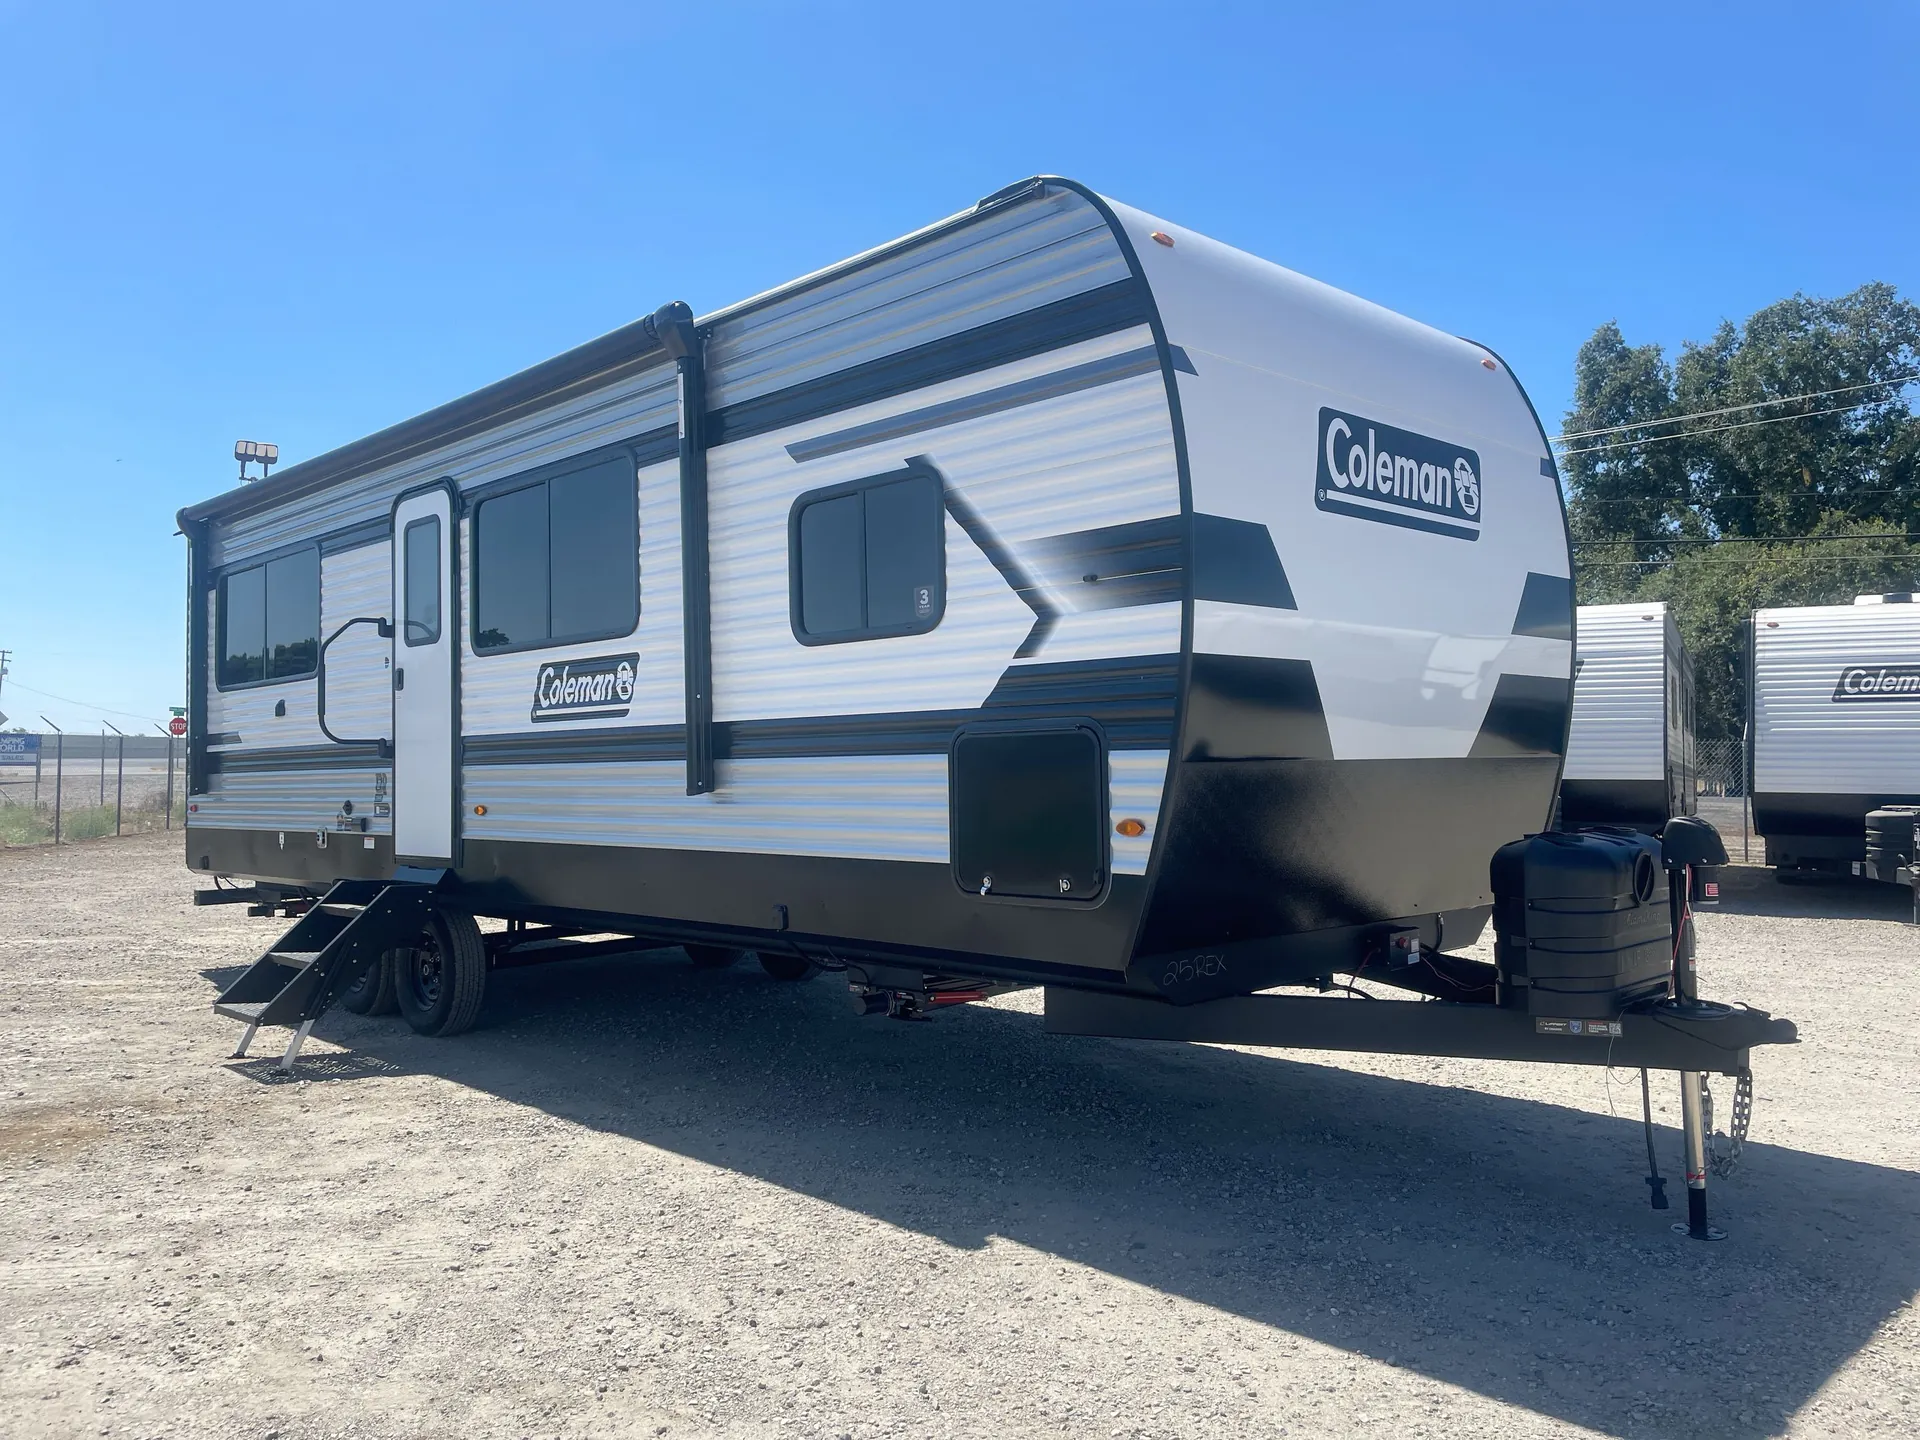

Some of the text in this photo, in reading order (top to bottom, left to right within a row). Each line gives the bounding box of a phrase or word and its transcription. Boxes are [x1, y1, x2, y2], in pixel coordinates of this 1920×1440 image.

[1326, 417, 1452, 509] Coleman
[919, 589, 929, 604] 3
[538, 665, 615, 708] Coleman
[1844, 669, 1920, 694] Colem
[170, 722, 187, 731] STOP
[0, 744, 24, 753] ORLD
